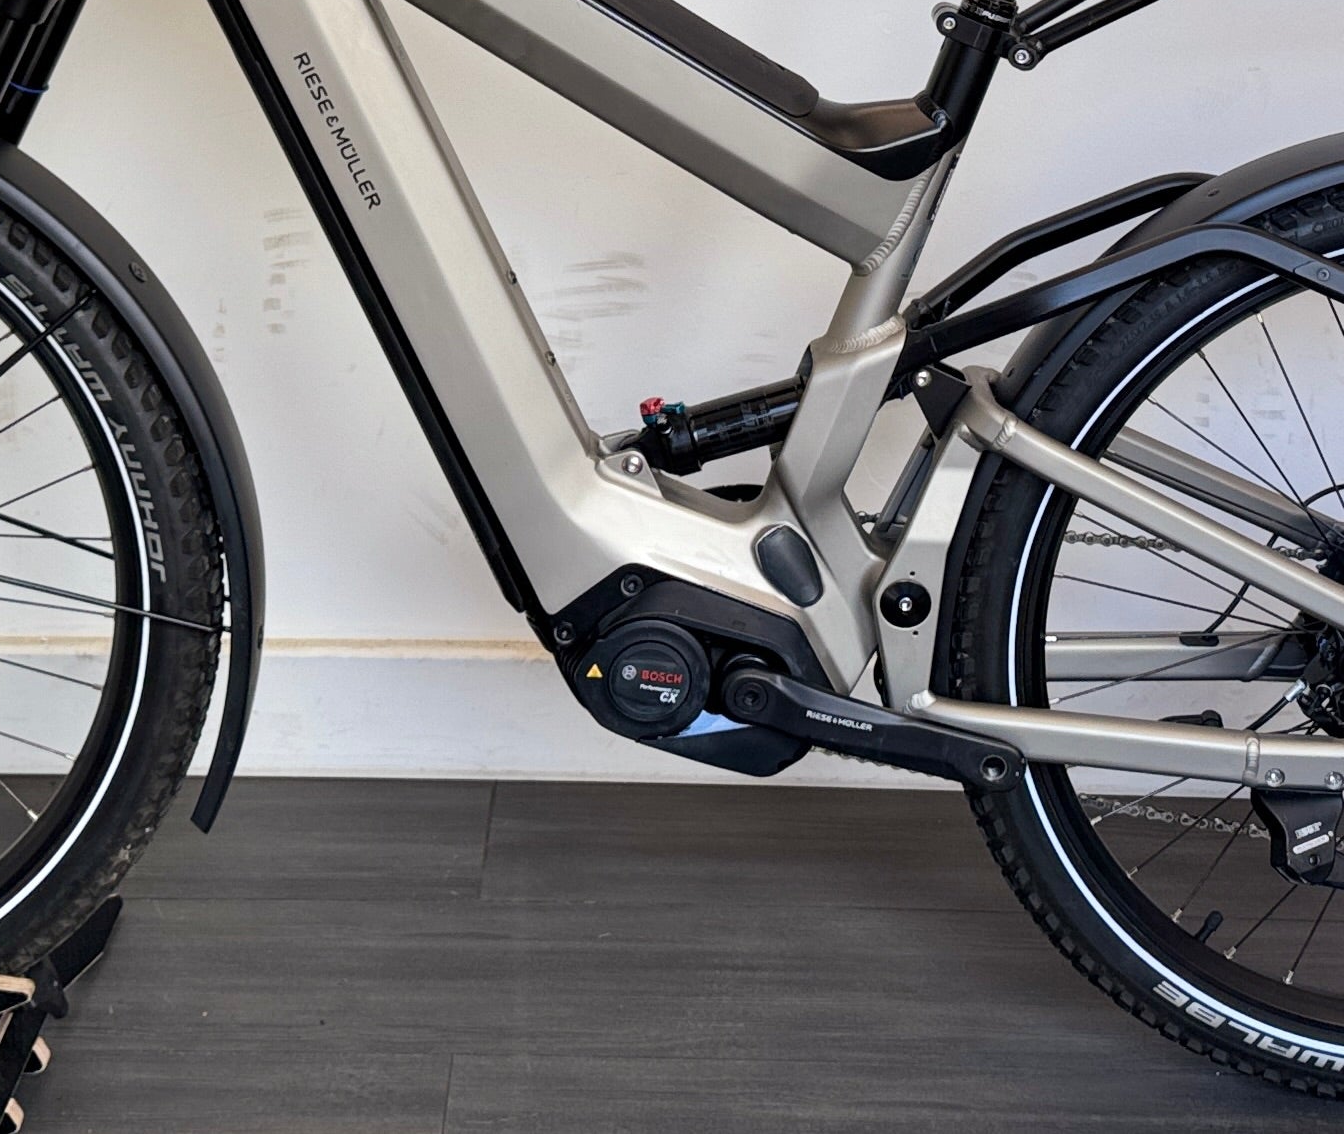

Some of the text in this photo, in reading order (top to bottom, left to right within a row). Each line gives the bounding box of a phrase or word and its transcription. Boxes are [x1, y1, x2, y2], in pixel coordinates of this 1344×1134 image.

[293, 52, 335, 115] RIESE
[331, 127, 381, 210] MÜLLER
[641, 670, 684, 684] BOSCH
[659, 691, 679, 704] CX
